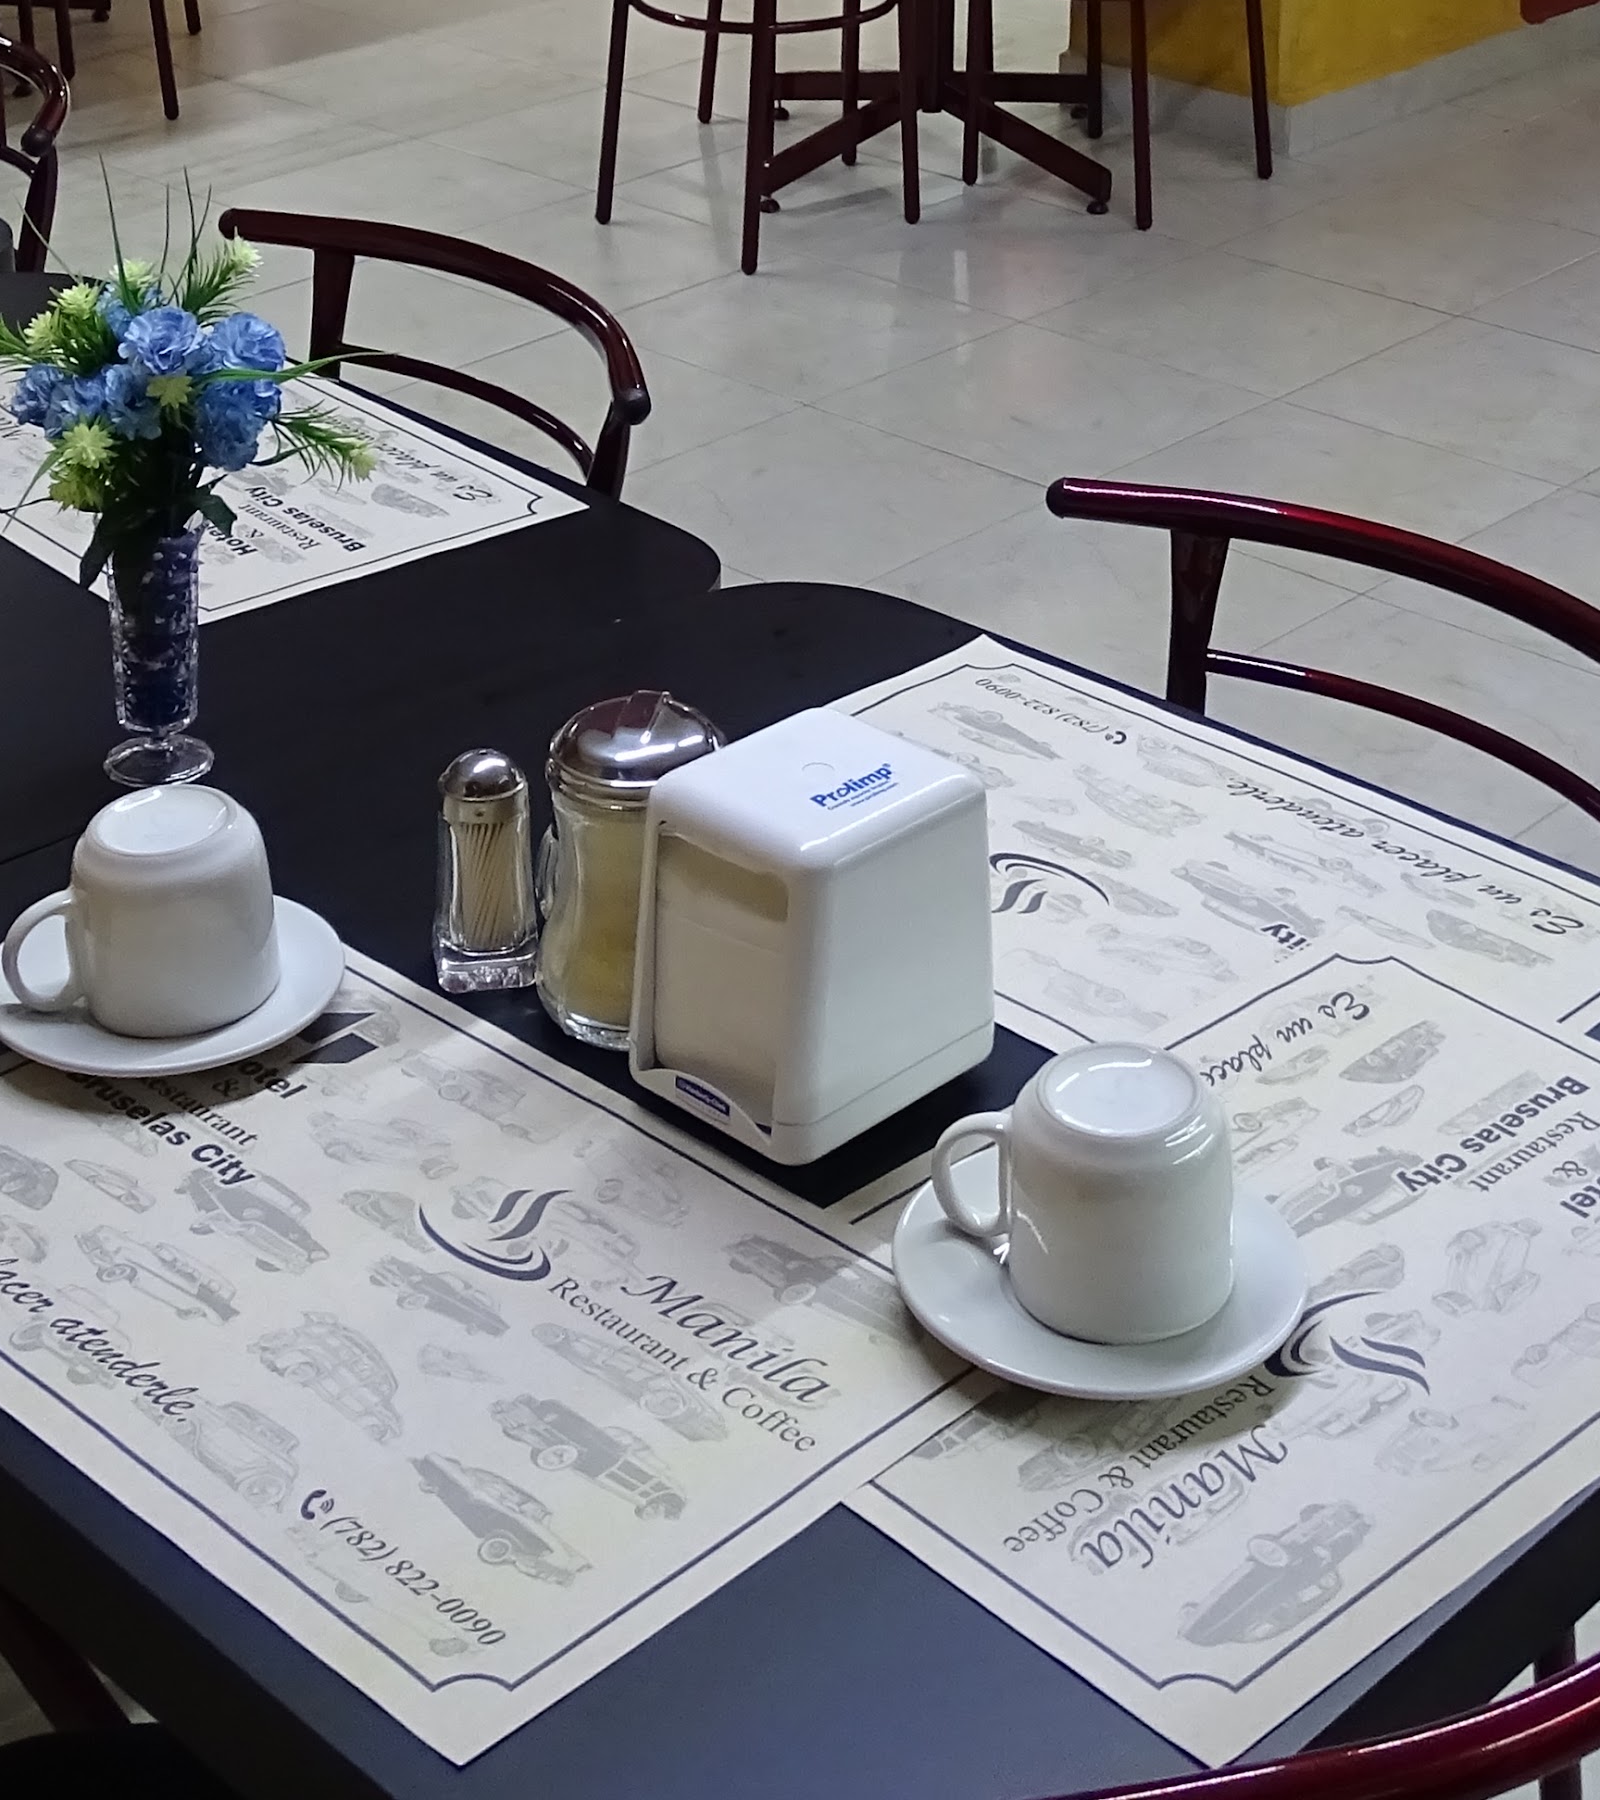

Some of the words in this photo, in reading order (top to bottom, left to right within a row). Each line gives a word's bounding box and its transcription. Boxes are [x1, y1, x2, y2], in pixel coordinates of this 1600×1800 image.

[245, 485, 283, 507] City
[430, 471, 458, 483] un
[453, 483, 492, 501] Es
[238, 503, 322, 551] Restaurant
[283, 505, 366, 552] Bruselas
[975, 678, 1061, 715] 822-0090
[1054, 713, 1109, 734] (782)
[1228, 776, 1365, 838] atenderle.
[1372, 839, 1482, 883] placer
[1477, 883, 1522, 904] un
[1262, 923, 1312, 951] ity
[1529, 908, 1584, 935] Es
[1318, 991, 1370, 1021] Es
[1277, 1017, 1314, 1043] un
[212, 1078, 240, 1097] &
[236, 1058, 308, 1099] otel
[141, 1077, 258, 1147] estaurant
[1460, 1075, 1590, 1153] Bruselas
[191, 1143, 256, 1186] City
[1396, 1153, 1468, 1193] City
[1552, 1160, 1588, 1178] &
[620, 1275, 832, 1404] Manila
[50, 1317, 200, 1422] atenderle.
[547, 1277, 689, 1373] Restaurant
[687, 1368, 720, 1391] &
[722, 1386, 816, 1452] Coffee
[1129, 1375, 1275, 1470] Restaurant
[1080, 1424, 1288, 1569] Manila
[1098, 1466, 1134, 1489] &
[1004, 1489, 1104, 1552] Coffee
[319, 1515, 395, 1564] (782)
[385, 1559, 507, 1646] 822-0090
